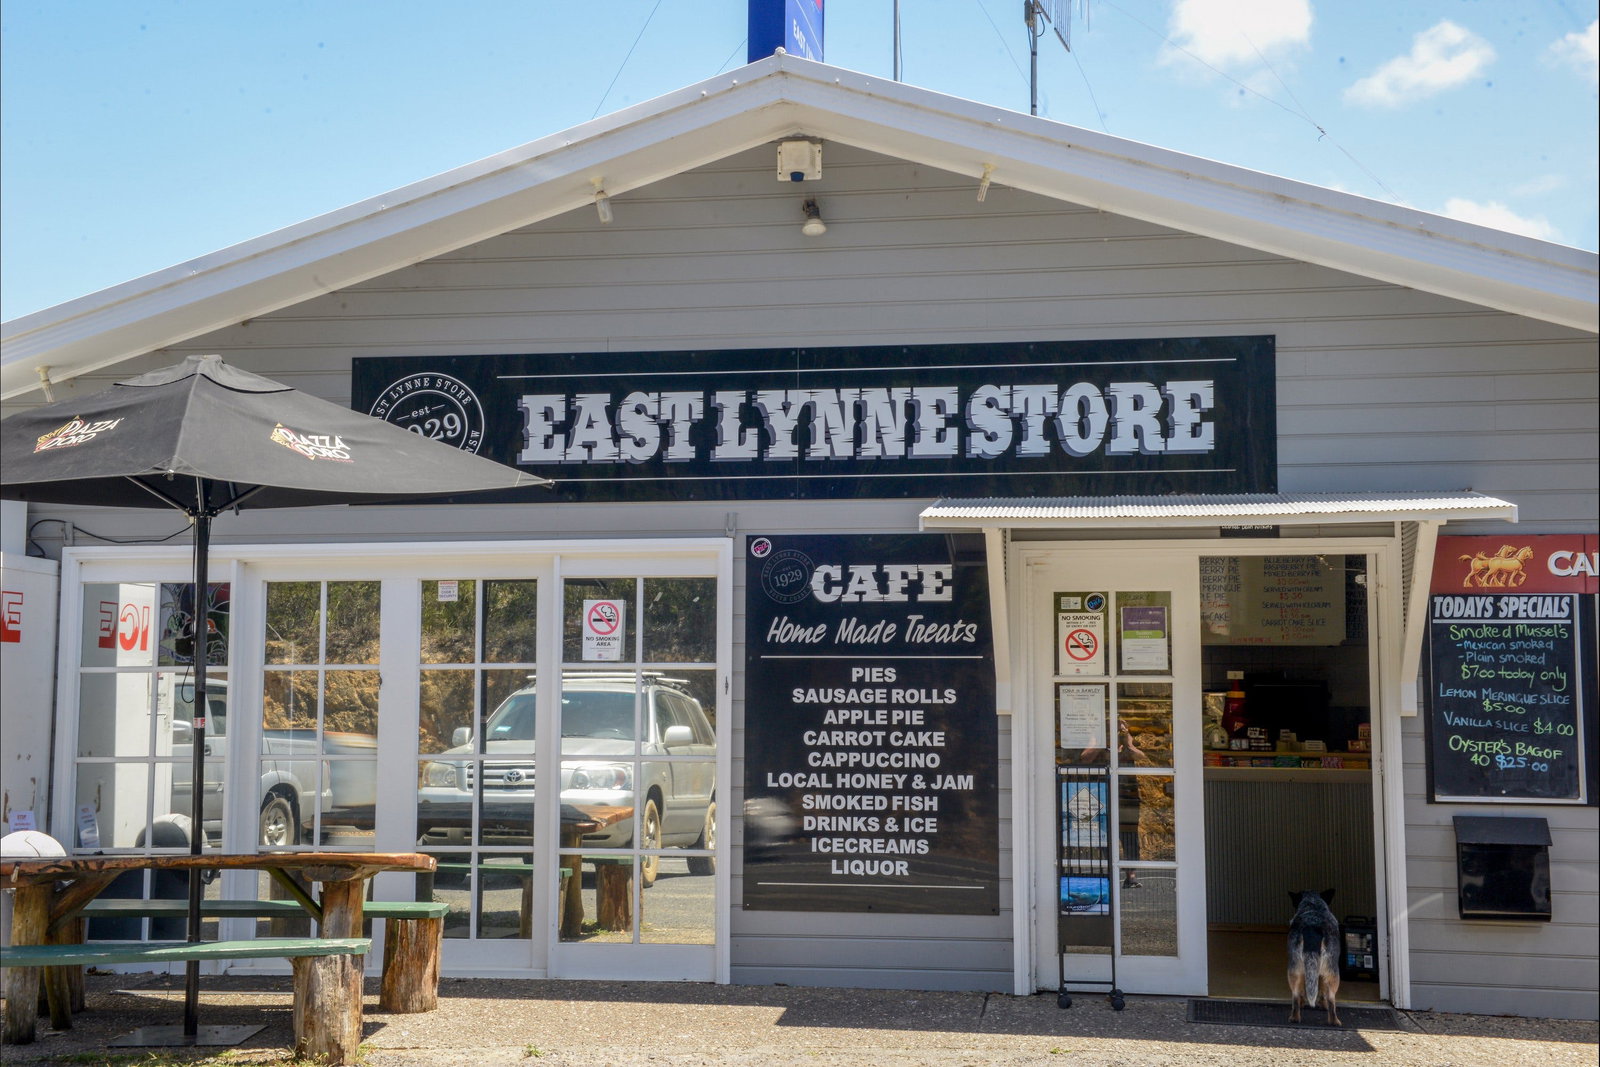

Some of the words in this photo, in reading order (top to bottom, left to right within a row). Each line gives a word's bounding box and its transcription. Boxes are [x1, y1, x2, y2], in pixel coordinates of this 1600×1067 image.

[390, 378, 430, 400] LYNNE
[436, 378, 472, 405] STORE
[411, 405, 430, 418] est
[408, 413, 461, 440] 29
[517, 391, 703, 465] EAST
[710, 386, 959, 463] LYNNE
[965, 380, 1215, 460] STORE
[774, 569, 803, 587] 1929
[810, 564, 953, 603] CAFE
[1228, 575, 1241, 584] PIE
[1202, 584, 1241, 592] MERINGUE
[1434, 596, 1494, 618] TODAYS
[1497, 596, 1570, 619] SPECIALS
[767, 615, 827, 644] Home
[834, 616, 897, 644] Made
[904, 614, 978, 644] Treats
[1516, 624, 1568, 639] Mussel's
[1510, 639, 1554, 650] smoked
[1500, 652, 1546, 664] smoked
[851, 667, 897, 683] PIES
[1498, 665, 1535, 688] today
[1540, 665, 1567, 692] only
[792, 688, 887, 704] SAUSAGE
[891, 688, 957, 704] ROLLS
[1439, 682, 1478, 699] LEMON
[1481, 688, 1538, 704] MERINGUE
[1539, 694, 1570, 705] SLICE
[823, 710, 888, 725] APPLE
[892, 710, 924, 726] PIE
[1443, 711, 1492, 728] VANILLA
[1495, 720, 1530, 732] SLICE
[803, 730, 886, 746] CARROT
[889, 731, 946, 747] CAKE
[1448, 734, 1512, 755] OYSTER'S
[808, 752, 941, 768] CAPPUCCINO
[1470, 754, 1490, 767] 40
[1494, 754, 1548, 772] $25.00
[767, 772, 832, 788] LOCAL
[836, 773, 907, 790] HONEY
[911, 774, 927, 790] &
[930, 774, 974, 790] JAM
[802, 794, 888, 811] SMOKED
[892, 796, 938, 812] FISH
[803, 816, 880, 832] DRINKS
[884, 817, 900, 833] &
[904, 818, 938, 833] ICE
[811, 838, 930, 854] ICECREAMS
[831, 859, 910, 876] LIQUOR
